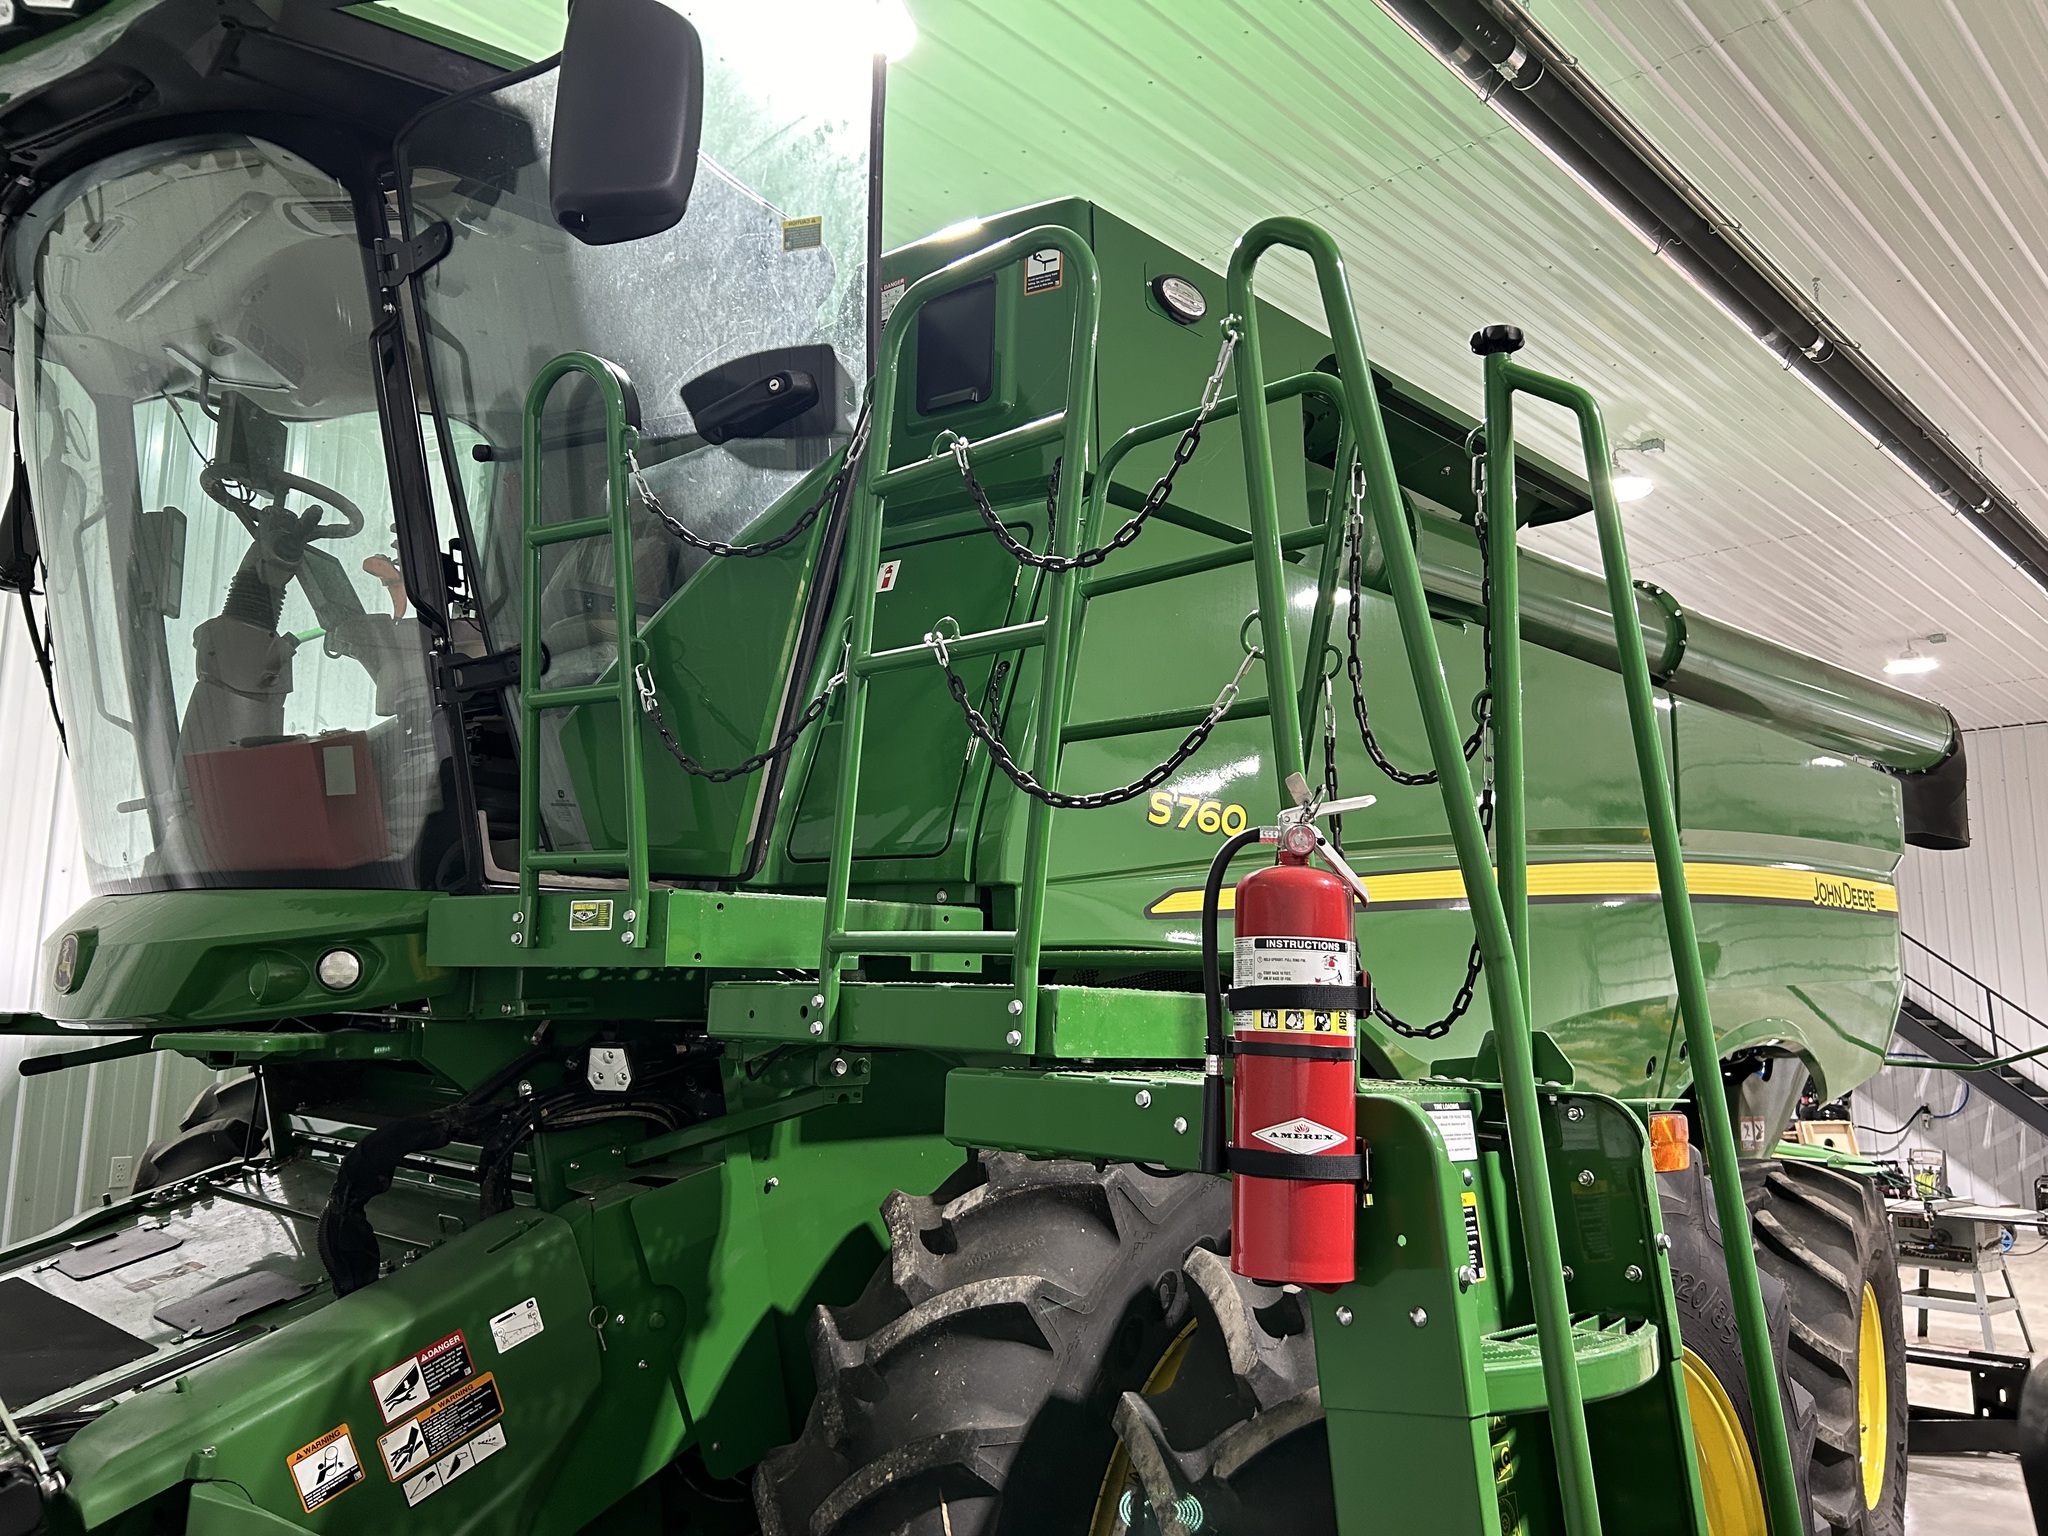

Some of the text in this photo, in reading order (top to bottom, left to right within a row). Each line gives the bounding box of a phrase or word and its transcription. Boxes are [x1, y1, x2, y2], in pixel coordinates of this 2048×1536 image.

[883, 278, 905, 290] DANGER
[1147, 790, 1248, 837] S760
[1813, 877, 1876, 908] JOHN DEERE
[1266, 939, 1340, 951] INSTRUCTIONS
[1339, 1011, 1348, 1031] ABC
[1268, 1132, 1334, 1141] AMEREX
[427, 1334, 461, 1358] DANGER
[437, 1384, 474, 1408] WARNING
[303, 1429, 341, 1455] WARNING
